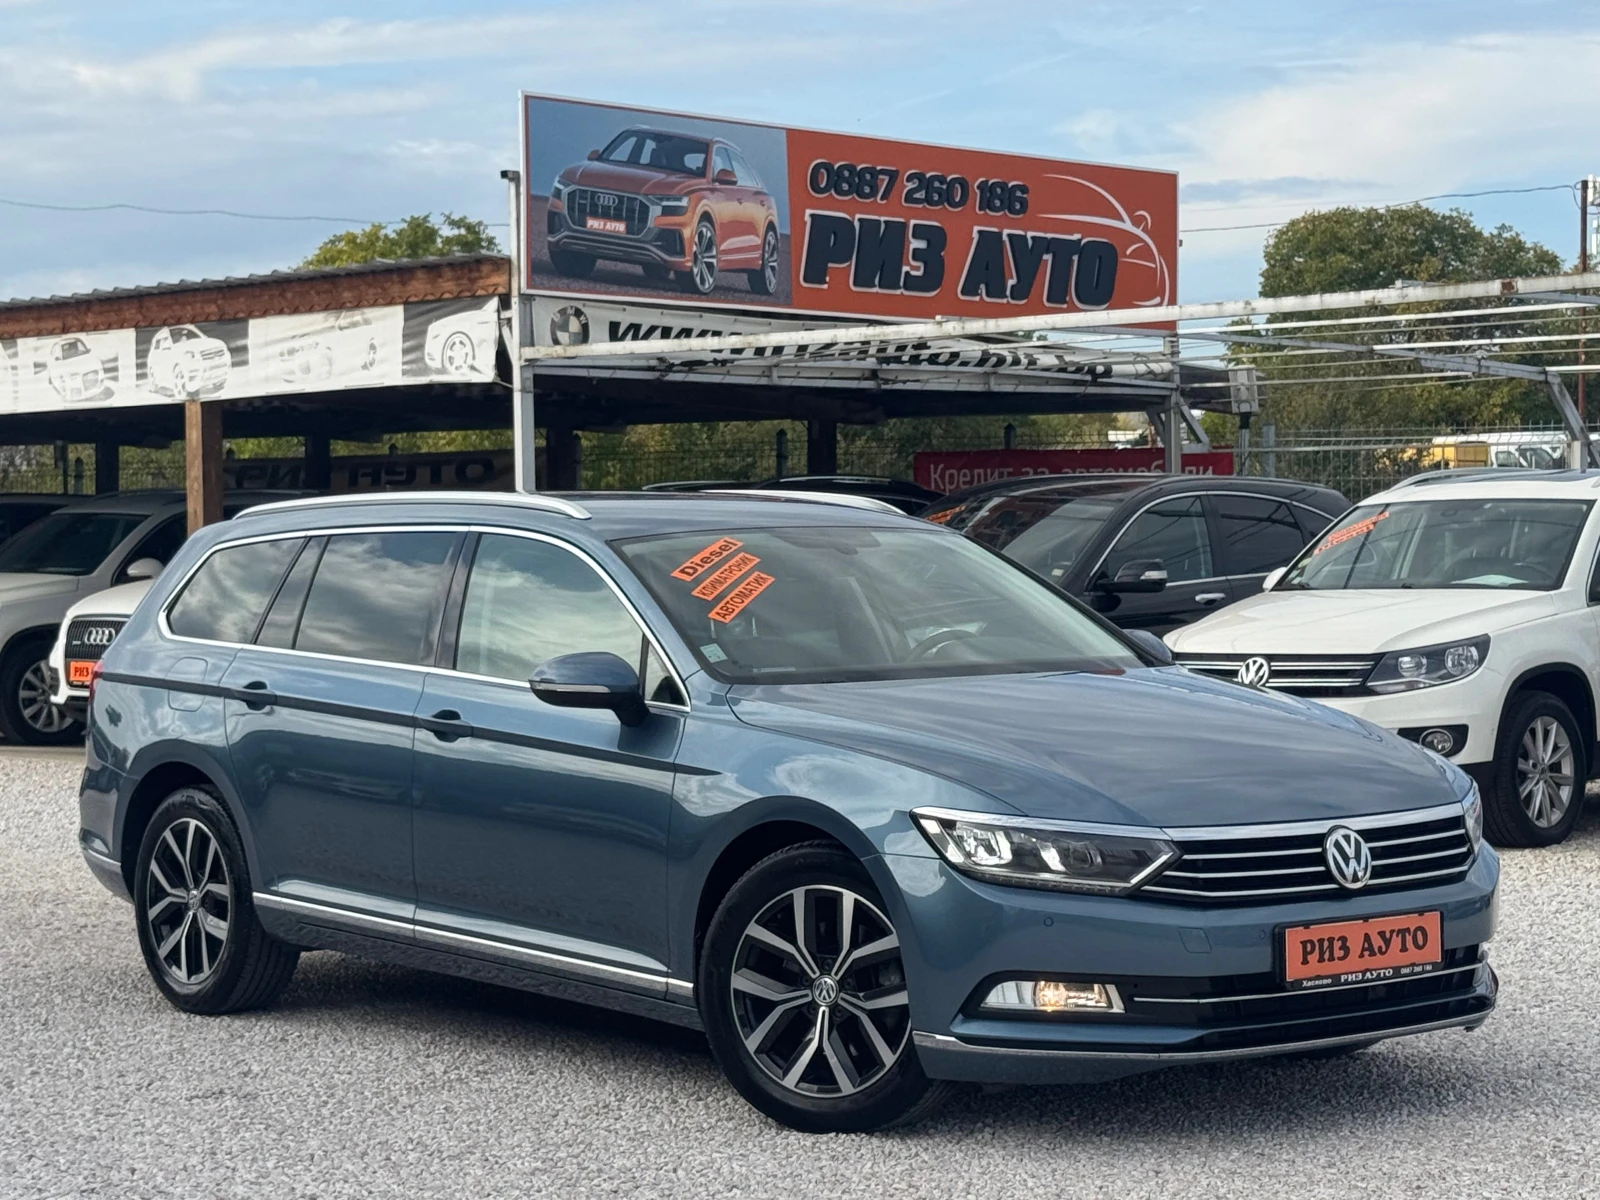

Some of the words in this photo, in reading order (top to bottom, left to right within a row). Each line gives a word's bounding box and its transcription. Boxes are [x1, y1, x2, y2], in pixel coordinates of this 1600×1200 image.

[807, 159, 900, 202] 0887
[903, 171, 969, 212] 260
[976, 179, 1030, 219] 186
[801, 209, 948, 296] РИЗ
[959, 229, 1119, 310] АУТО
[678, 539, 738, 577] Diesel
[697, 554, 755, 598] КЛИМАТРОНИК
[715, 574, 771, 620] АВТОМАТИК
[1299, 936, 1351, 966] РИЗ
[1358, 925, 1429, 959] АУТО
[1340, 973, 1363, 983] РИЗ
[1364, 968, 1394, 980] АУТО
